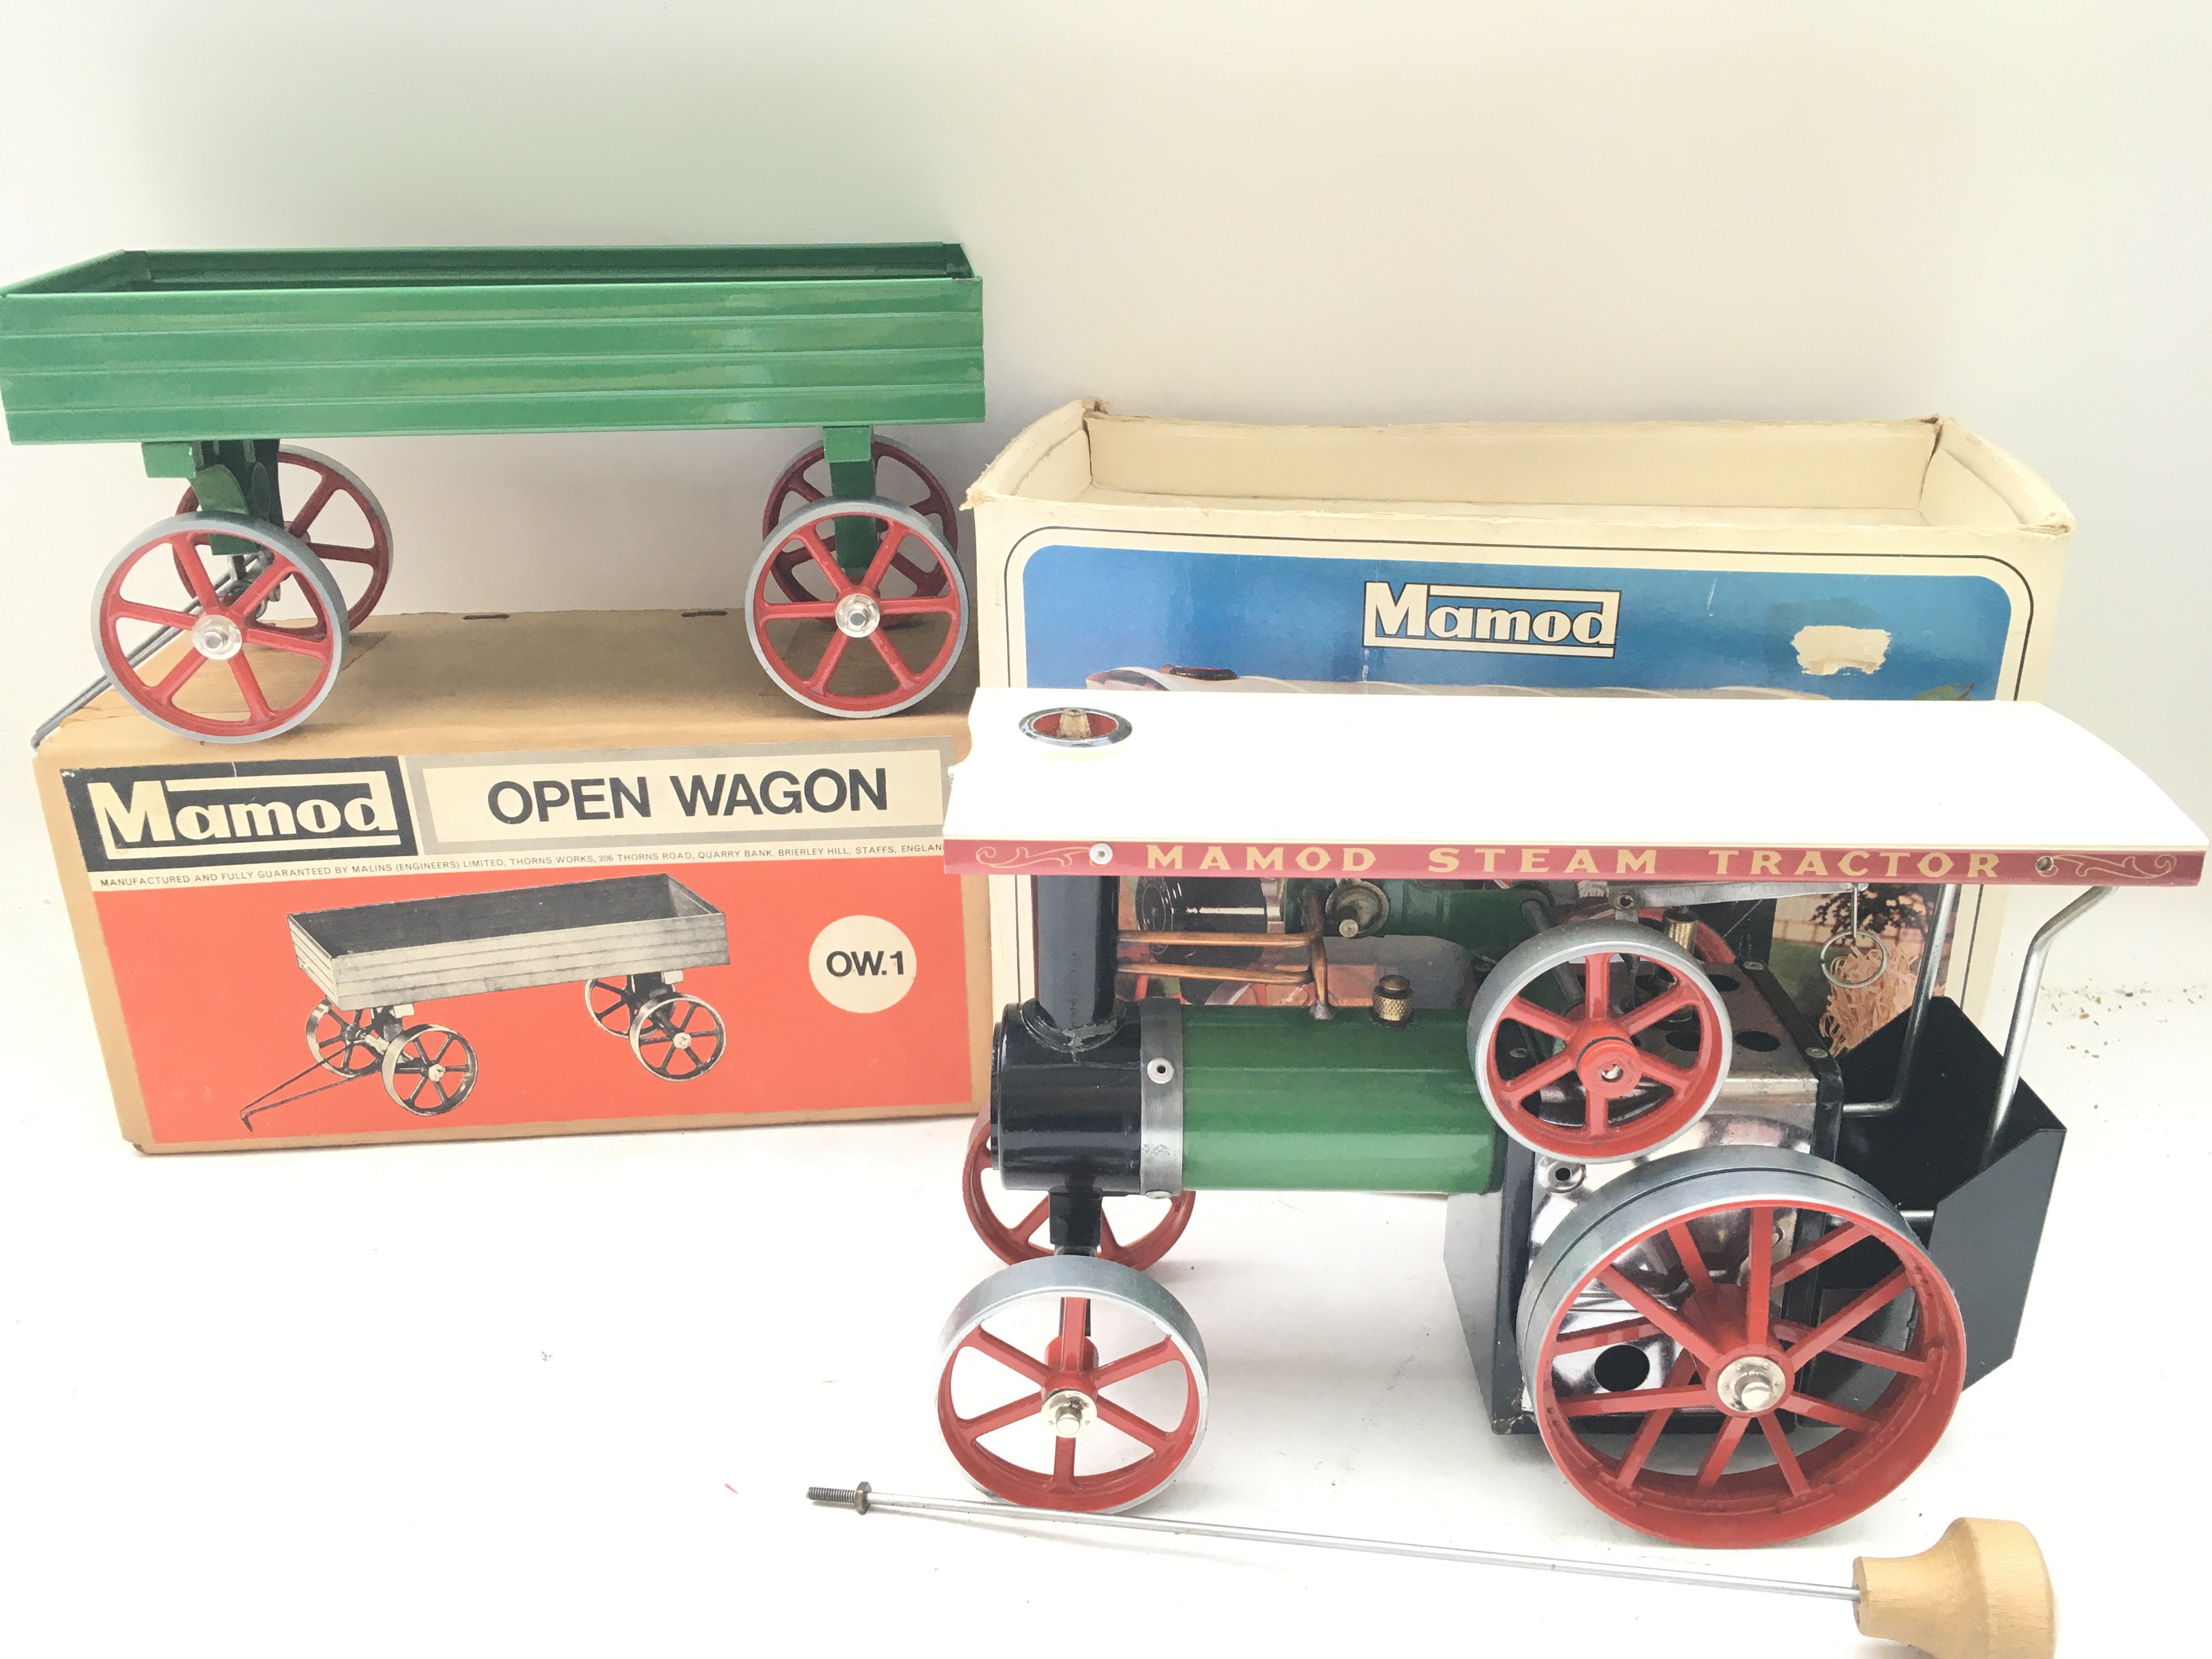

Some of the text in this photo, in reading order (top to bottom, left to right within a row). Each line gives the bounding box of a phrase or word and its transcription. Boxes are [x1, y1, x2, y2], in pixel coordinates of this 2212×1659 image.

[1363, 581, 1622, 658] Mamod
[88, 771, 400, 860] Mamod
[488, 768, 888, 825] OPEN WAGON
[100, 876, 190, 887] MANUFACTURED
[194, 873, 218, 882] AND
[221, 871, 253, 880] FULLY
[257, 867, 332, 878] GUARANTEED
[352, 864, 393, 873] MALINS
[395, 861, 460, 871] (ENGINEERS)
[462, 859, 506, 868] LIMITED,
[510, 857, 552, 865] THORNS
[555, 855, 596, 864] WORKS,
[617, 853, 659, 861] THORNS
[662, 851, 695, 860] ROAD,
[698, 850, 741, 859] QUARRY
[744, 849, 775, 857] BANK,
[778, 848, 824, 856] BRIERLEY
[827, 847, 851, 855] HILL,
[855, 845, 896, 854] STAFFS,
[901, 844, 944, 853] ENGLAN
[1146, 845, 2000, 878] MAMOD STEAM TRACTOR
[826, 950, 904, 977] OW.1
